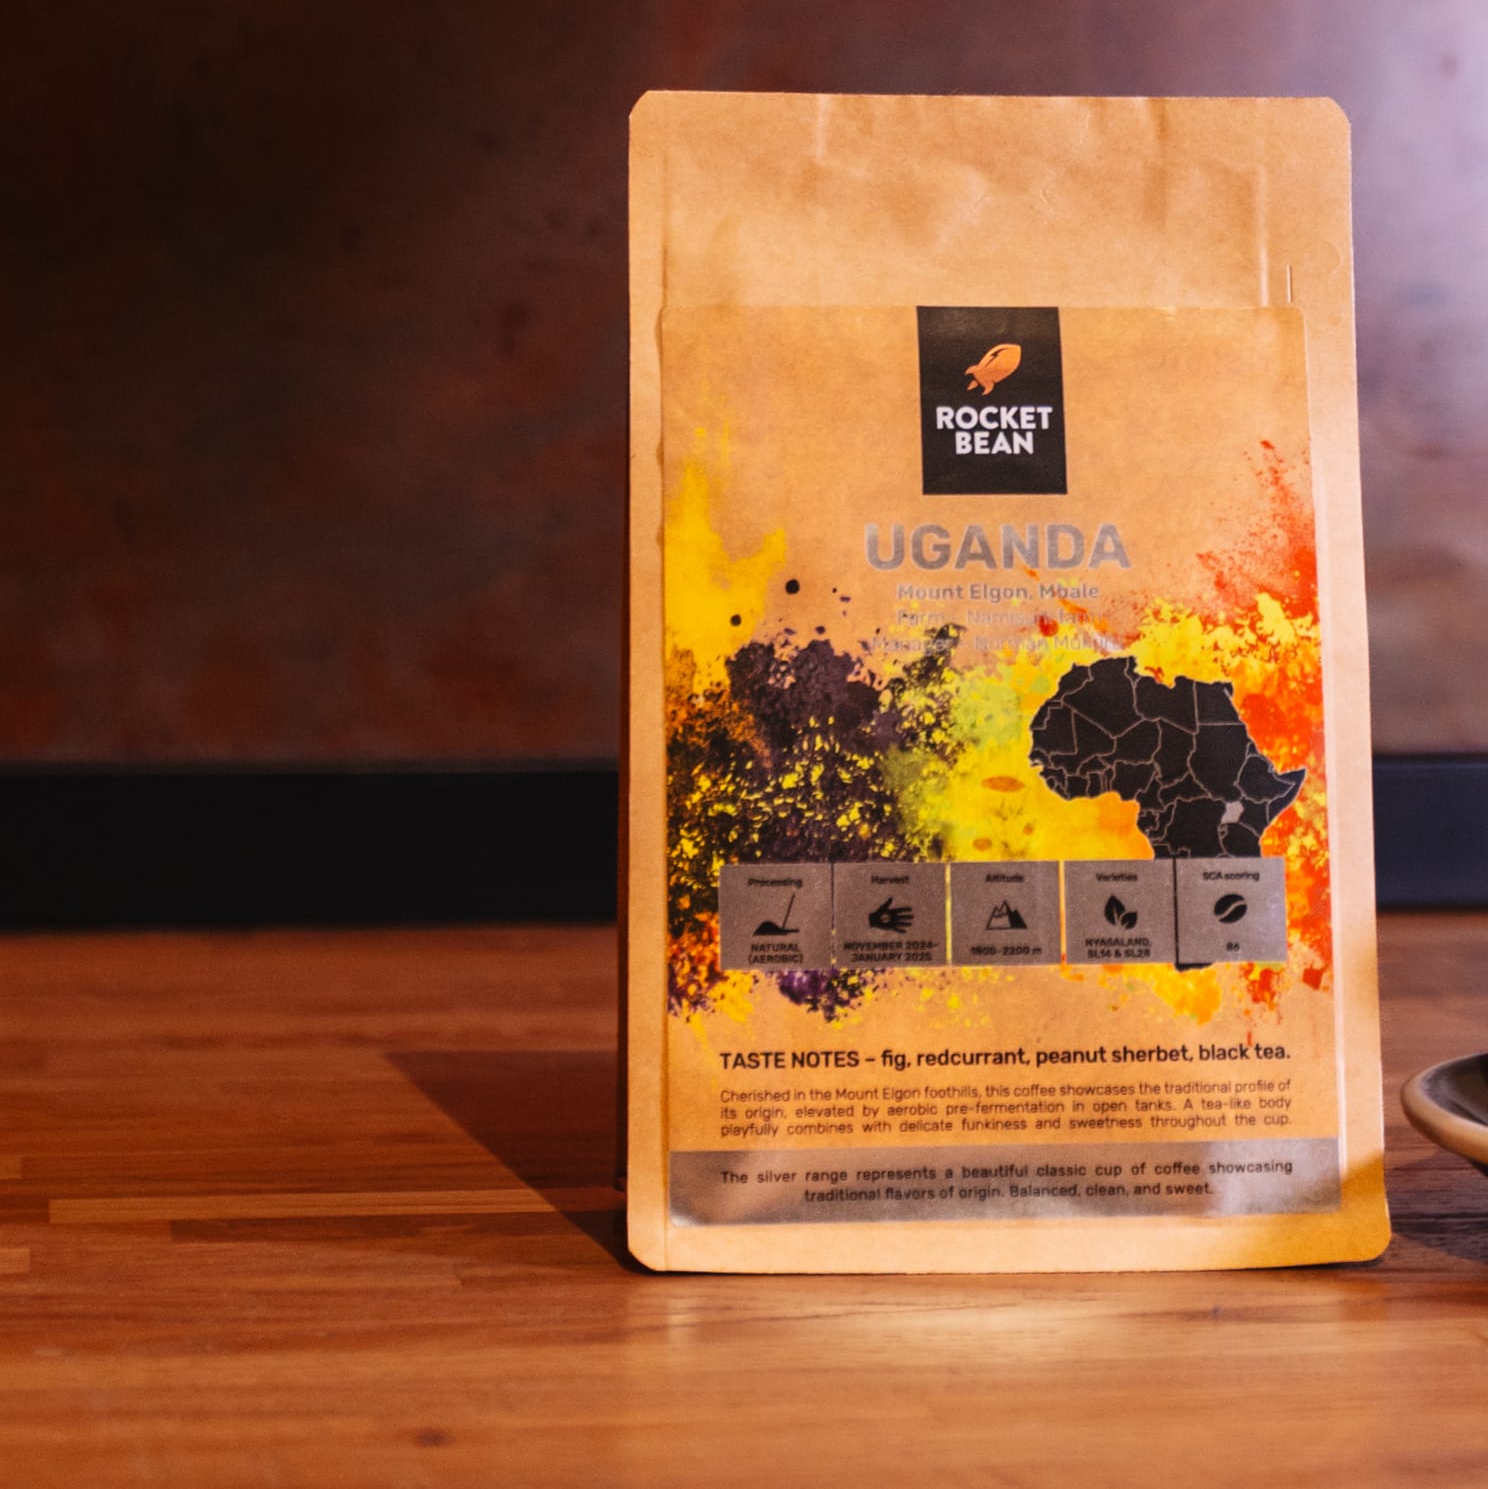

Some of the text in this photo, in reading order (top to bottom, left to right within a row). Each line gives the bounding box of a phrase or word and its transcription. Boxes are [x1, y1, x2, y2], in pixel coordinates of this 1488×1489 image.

[935, 406, 1053, 430] ROCKET
[954, 431, 1034, 455] BEAN
[864, 522, 1132, 570] UGANDA
[896, 582, 1099, 604] Mount Elgon, Mbale
[748, 877, 803, 889] Processing
[871, 875, 910, 885] Harvest
[985, 873, 1024, 883] Altitude
[1096, 872, 1138, 882] Varieties
[1202, 871, 1260, 882] SCA scoring
[751, 943, 799, 953] NATURAL
[843, 941, 903, 952] NOVEMBER
[851, 951, 932, 963] JANUARY 2025
[748, 953, 804, 965] (AEROBIC)
[720, 1052, 785, 1070] TASTE
[791, 1051, 860, 1069] NOTES
[881, 1049, 912, 1071] fig,
[916, 1048, 1031, 1067] redcurrant,
[1036, 1047, 1107, 1068] peanut
[1111, 1045, 1194, 1063] sherbet,
[1199, 1044, 1249, 1061] black
[1254, 1043, 1291, 1059] tea.
[720, 1079, 1292, 1104] Cherished in the Mount Elgon foothills, this coffee showcases the traditional profile of
[720, 1095, 1292, 1121] its origin, elevated by aerobic pre-fermentation in open tanks. A tea-like body
[720, 1113, 1292, 1139] playfully combines with delicate funkiness and sweetness throughout the cup.
[721, 1161, 1293, 1184] The silver range represents a beautiful classic cup of coffee showcasing
[804, 1181, 1214, 1203] traditional flavors of origin. Balanced, clean, and sweet.
